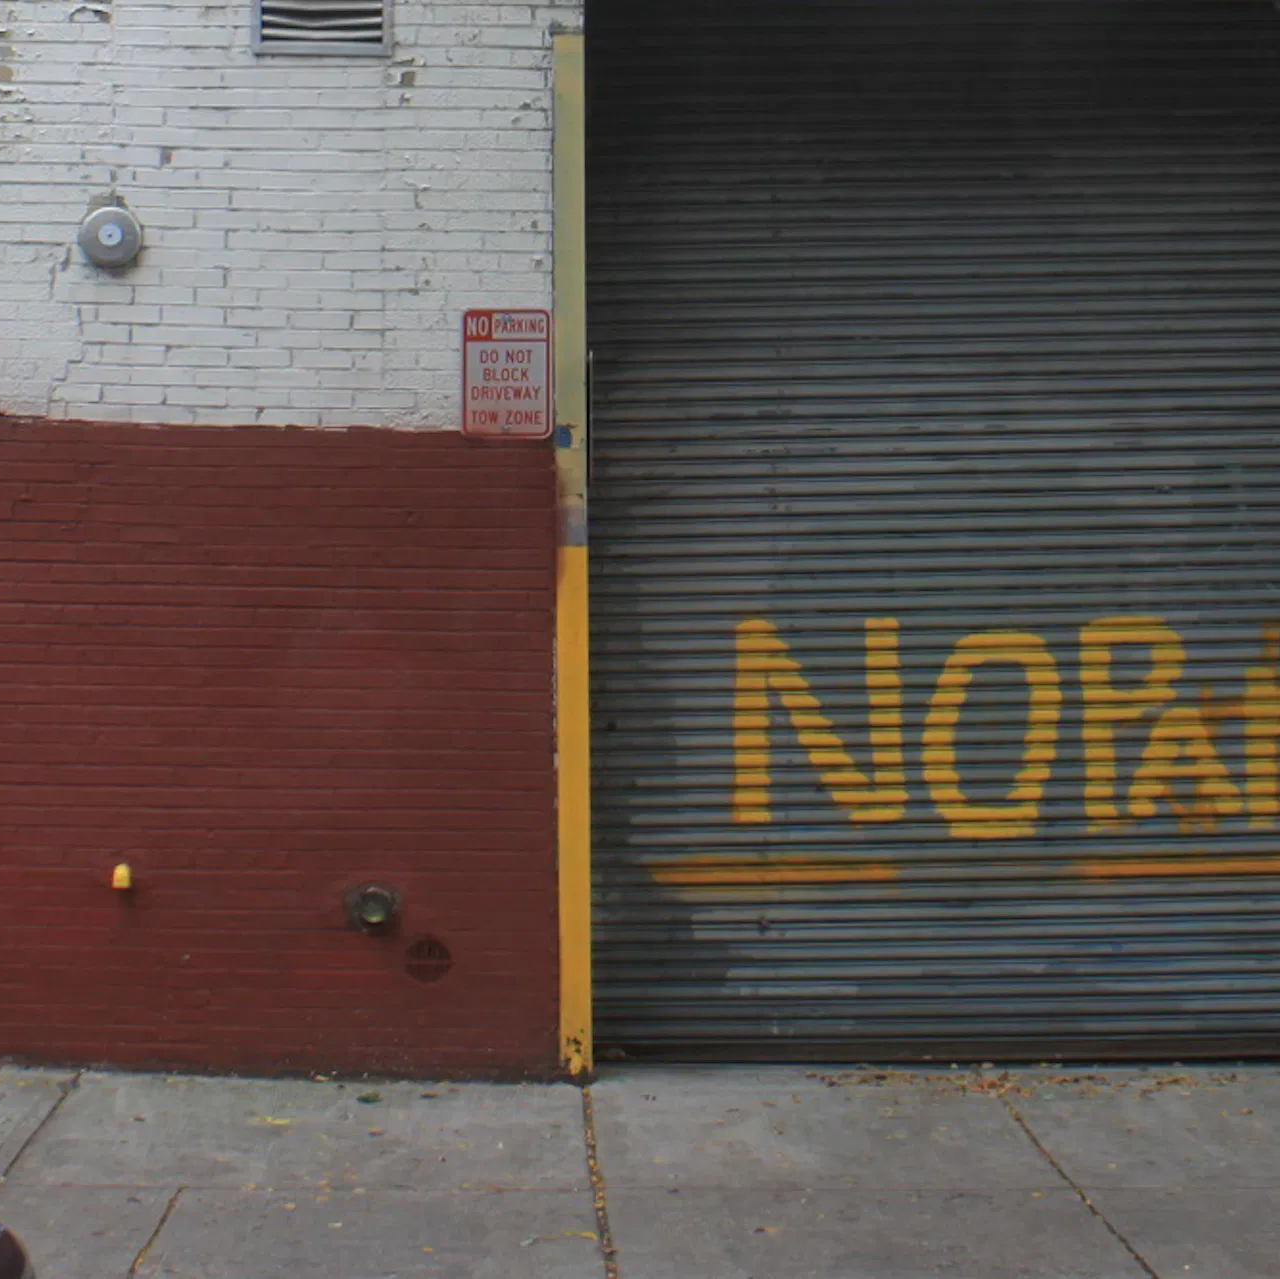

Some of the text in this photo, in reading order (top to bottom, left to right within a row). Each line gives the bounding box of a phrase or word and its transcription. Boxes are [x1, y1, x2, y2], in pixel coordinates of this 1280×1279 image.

[466, 316, 545, 336] NO PARKING
[480, 349, 533, 364] DO NOT
[483, 368, 529, 381] BLOCK
[471, 386, 542, 401] DRIVEWAY
[471, 410, 542, 425] TOW ZONE
[733, 617, 1062, 838] NO
